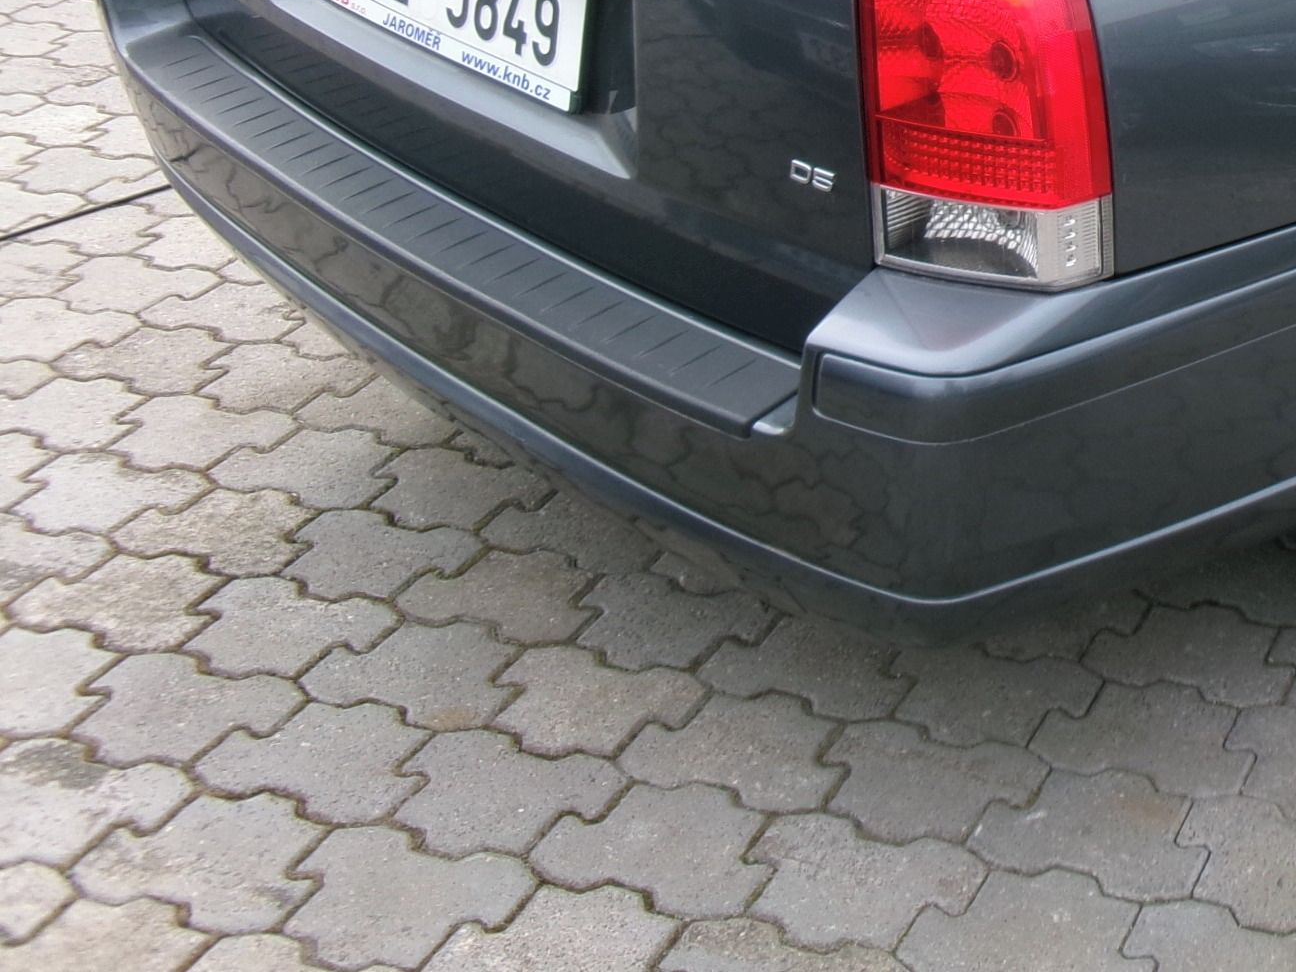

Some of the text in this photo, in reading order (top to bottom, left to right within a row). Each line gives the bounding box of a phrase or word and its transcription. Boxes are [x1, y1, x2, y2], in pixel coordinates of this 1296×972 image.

[382, 12, 443, 51] JAROMĚŘ
[461, 50, 551, 101] www.knb.cz
[789, 159, 836, 192] D5
